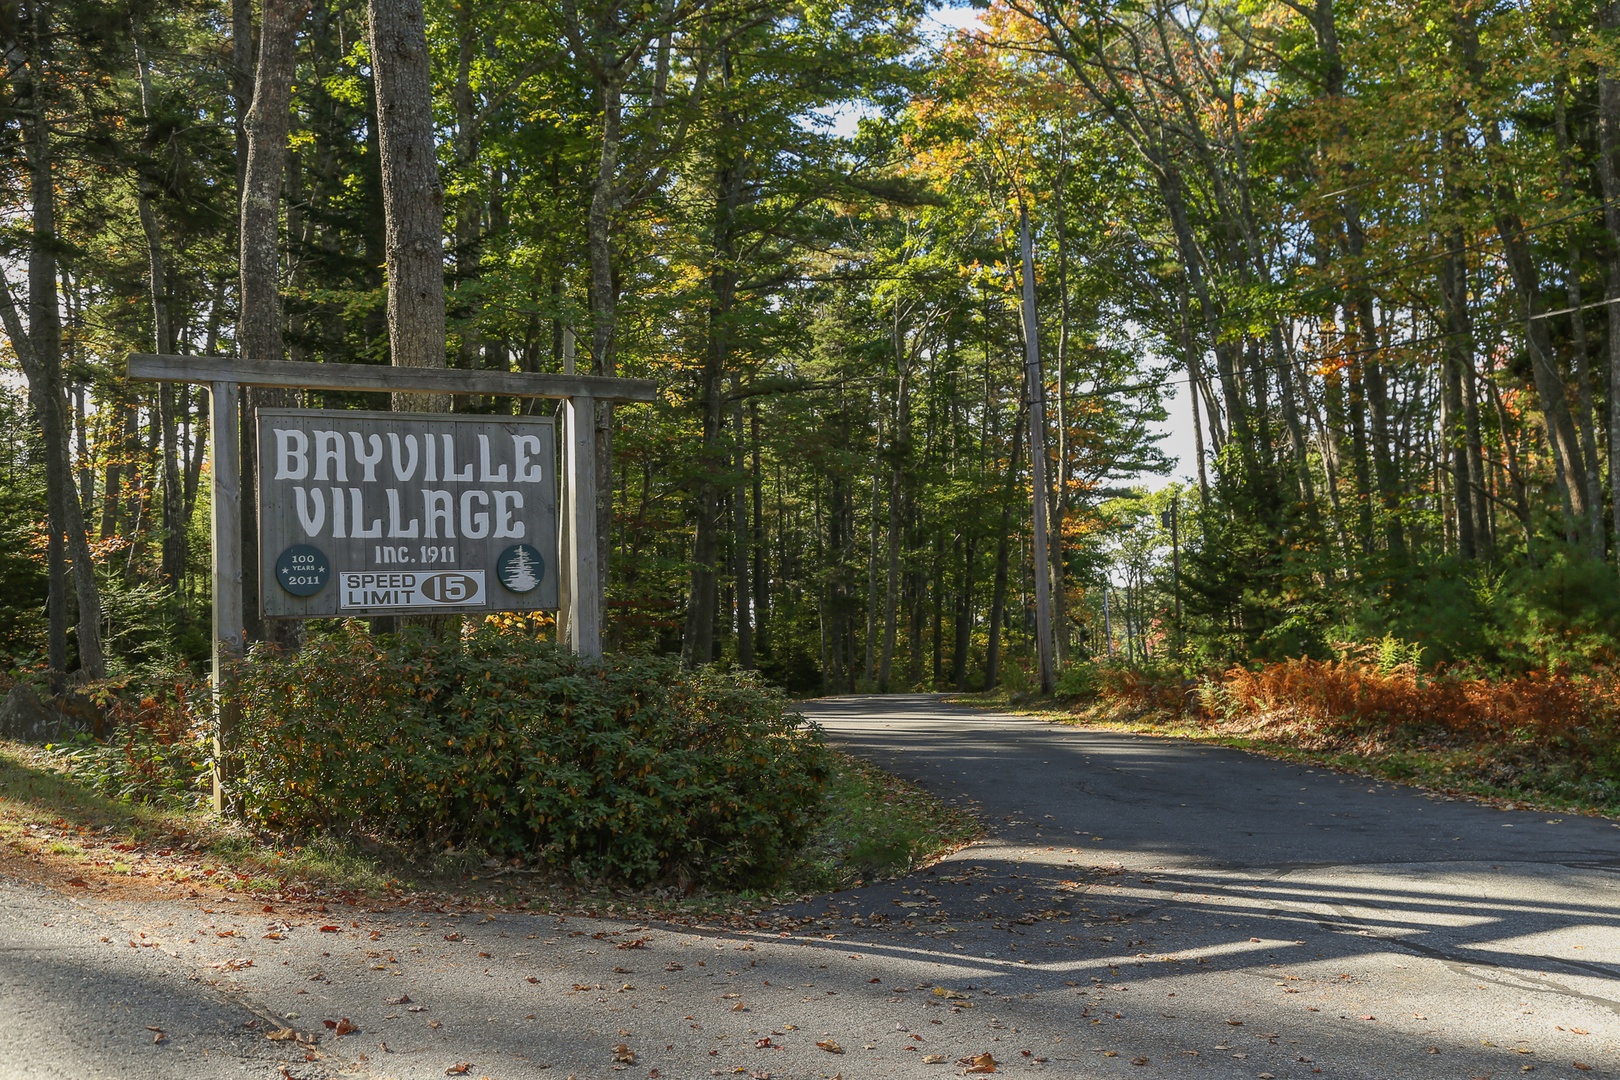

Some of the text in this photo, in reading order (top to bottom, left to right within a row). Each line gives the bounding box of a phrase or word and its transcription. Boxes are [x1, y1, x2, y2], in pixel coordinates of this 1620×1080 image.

[273, 428, 542, 483] BAYVILLE
[293, 486, 525, 539] VILLAGE
[292, 555, 315, 563] 100
[420, 545, 455, 563] 1911
[288, 576, 320, 585] 2011
[347, 574, 416, 588] SPEED
[433, 576, 467, 600] 15
[348, 590, 415, 605] LIMIT
